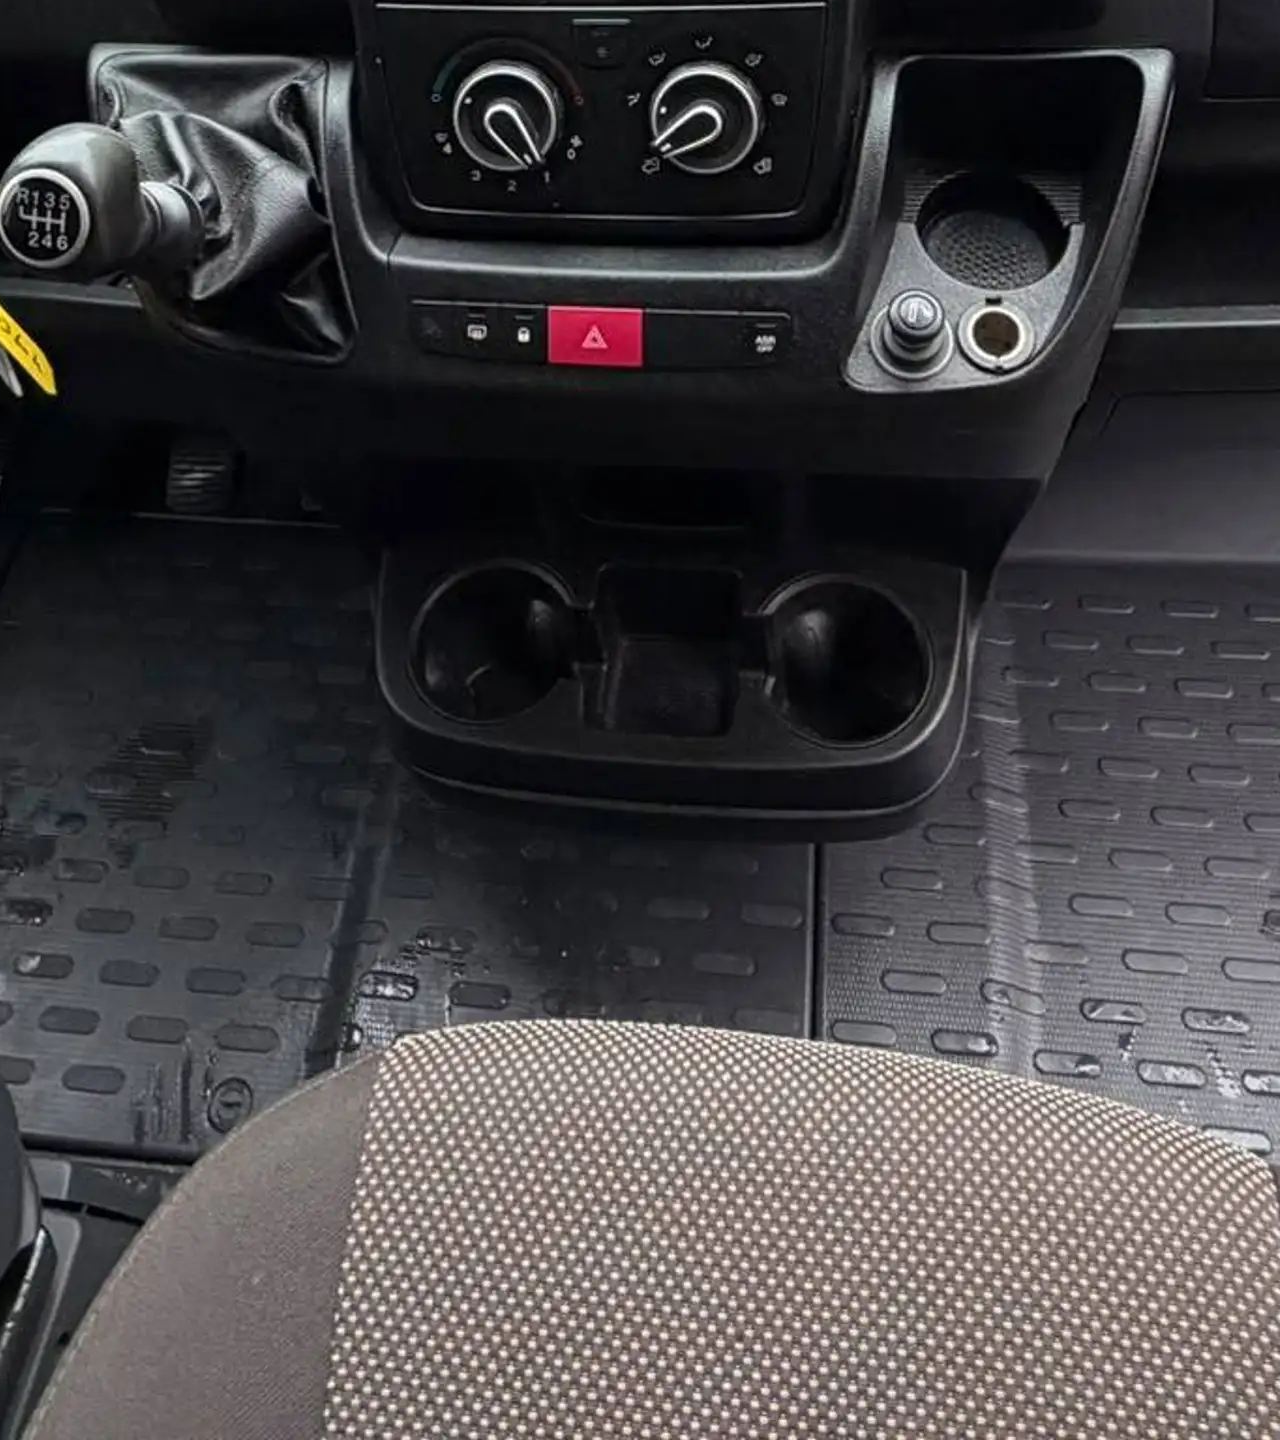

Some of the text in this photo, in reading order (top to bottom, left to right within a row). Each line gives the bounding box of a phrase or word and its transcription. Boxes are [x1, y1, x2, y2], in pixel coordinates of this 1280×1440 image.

[16, 188, 70, 212] R 1 3 5
[28, 231, 68, 251] 2 4 6
